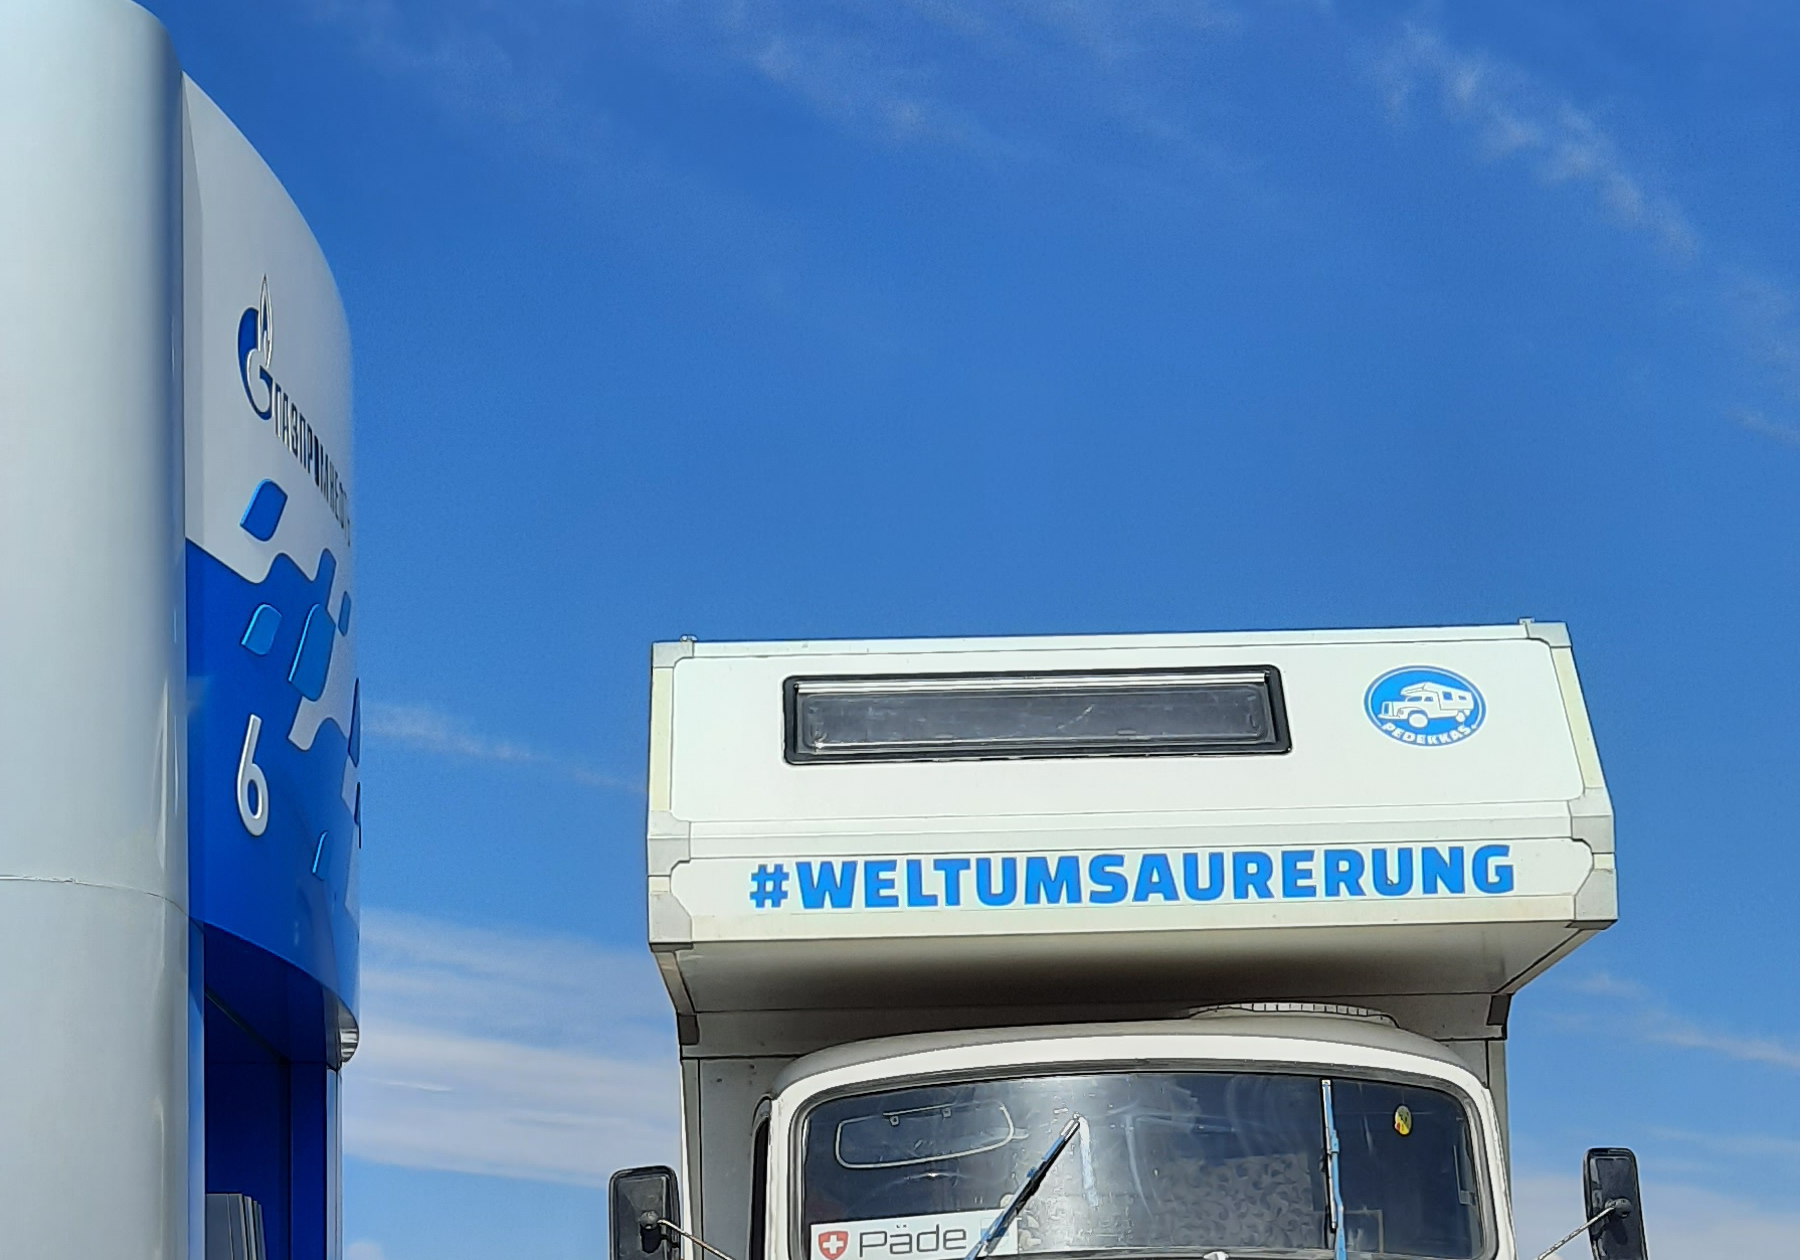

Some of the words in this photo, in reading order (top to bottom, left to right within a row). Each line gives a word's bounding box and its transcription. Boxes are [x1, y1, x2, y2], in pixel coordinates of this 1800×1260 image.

[236, 713, 269, 837] 6
[749, 844, 1515, 909] #WELTUMSAURERUNG
[858, 1223, 967, 1258] Päde
